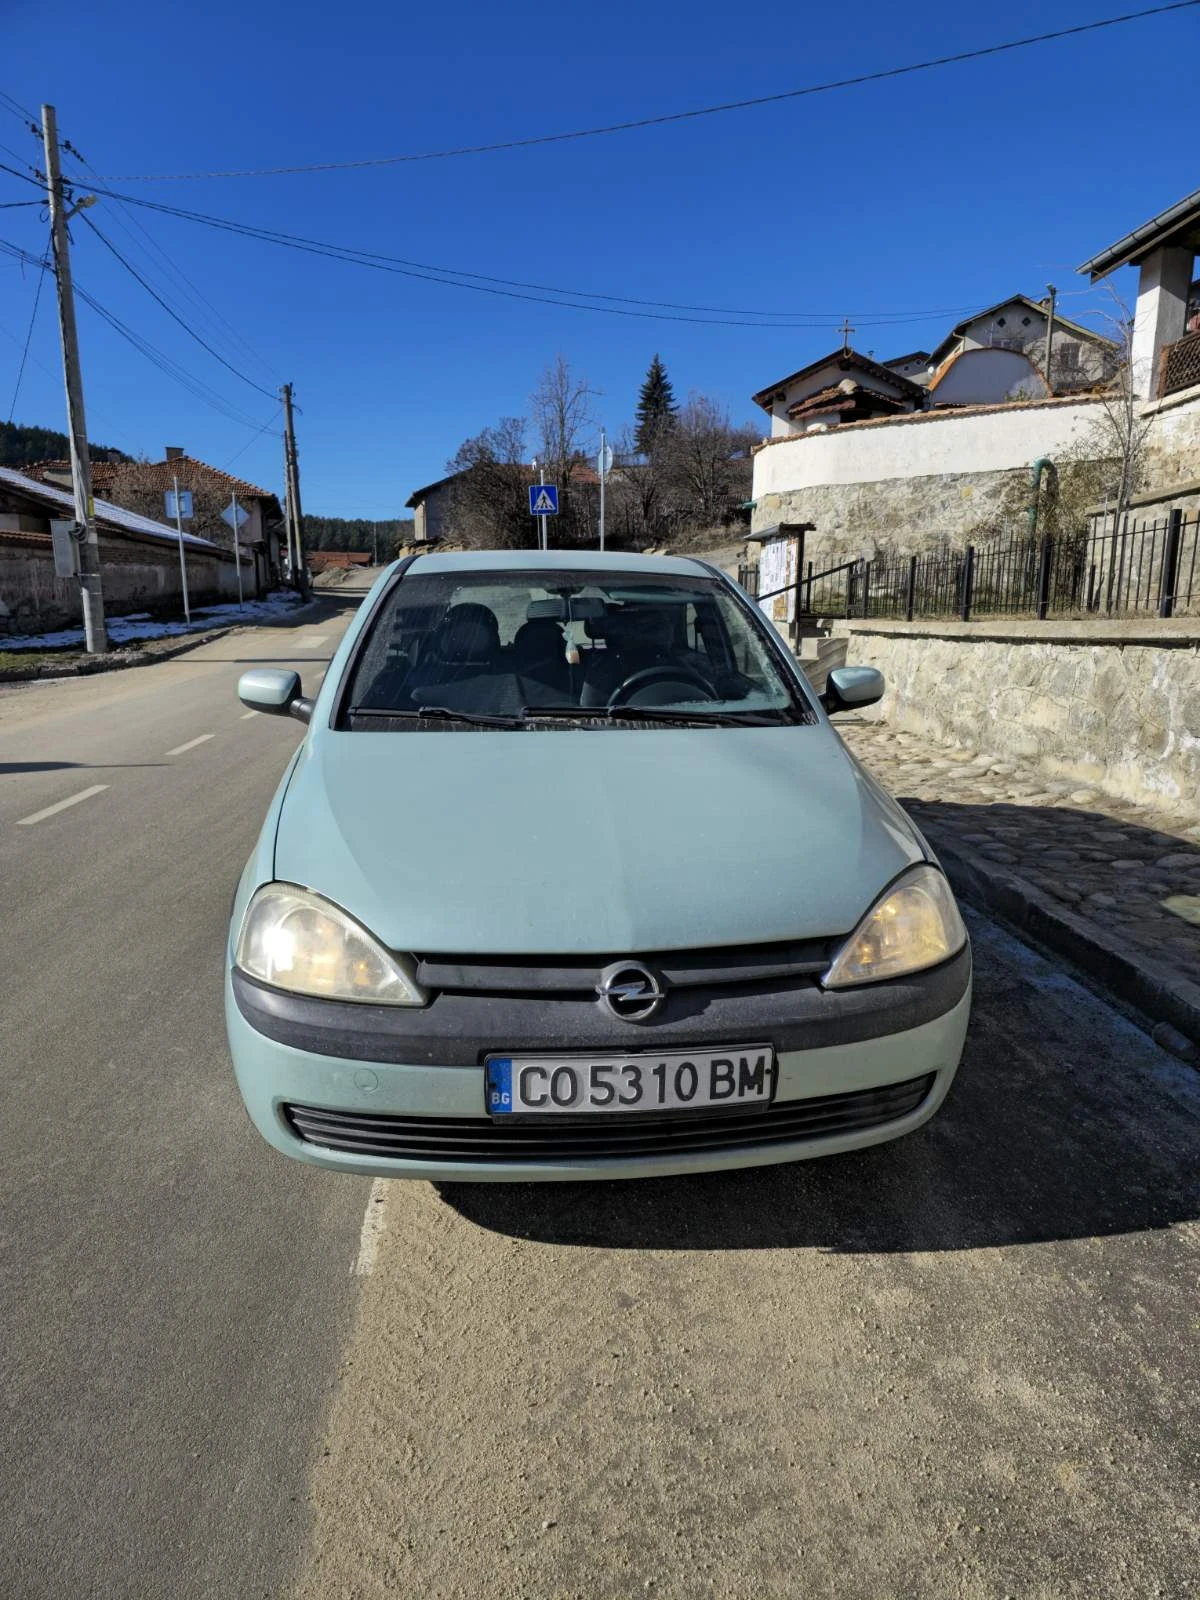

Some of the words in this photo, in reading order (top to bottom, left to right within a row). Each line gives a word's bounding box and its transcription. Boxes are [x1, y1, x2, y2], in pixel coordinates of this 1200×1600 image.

[519, 1066, 577, 1107] CO
[589, 1061, 699, 1106] 5310
[709, 1055, 766, 1101] BM
[491, 1092, 510, 1105] BG
